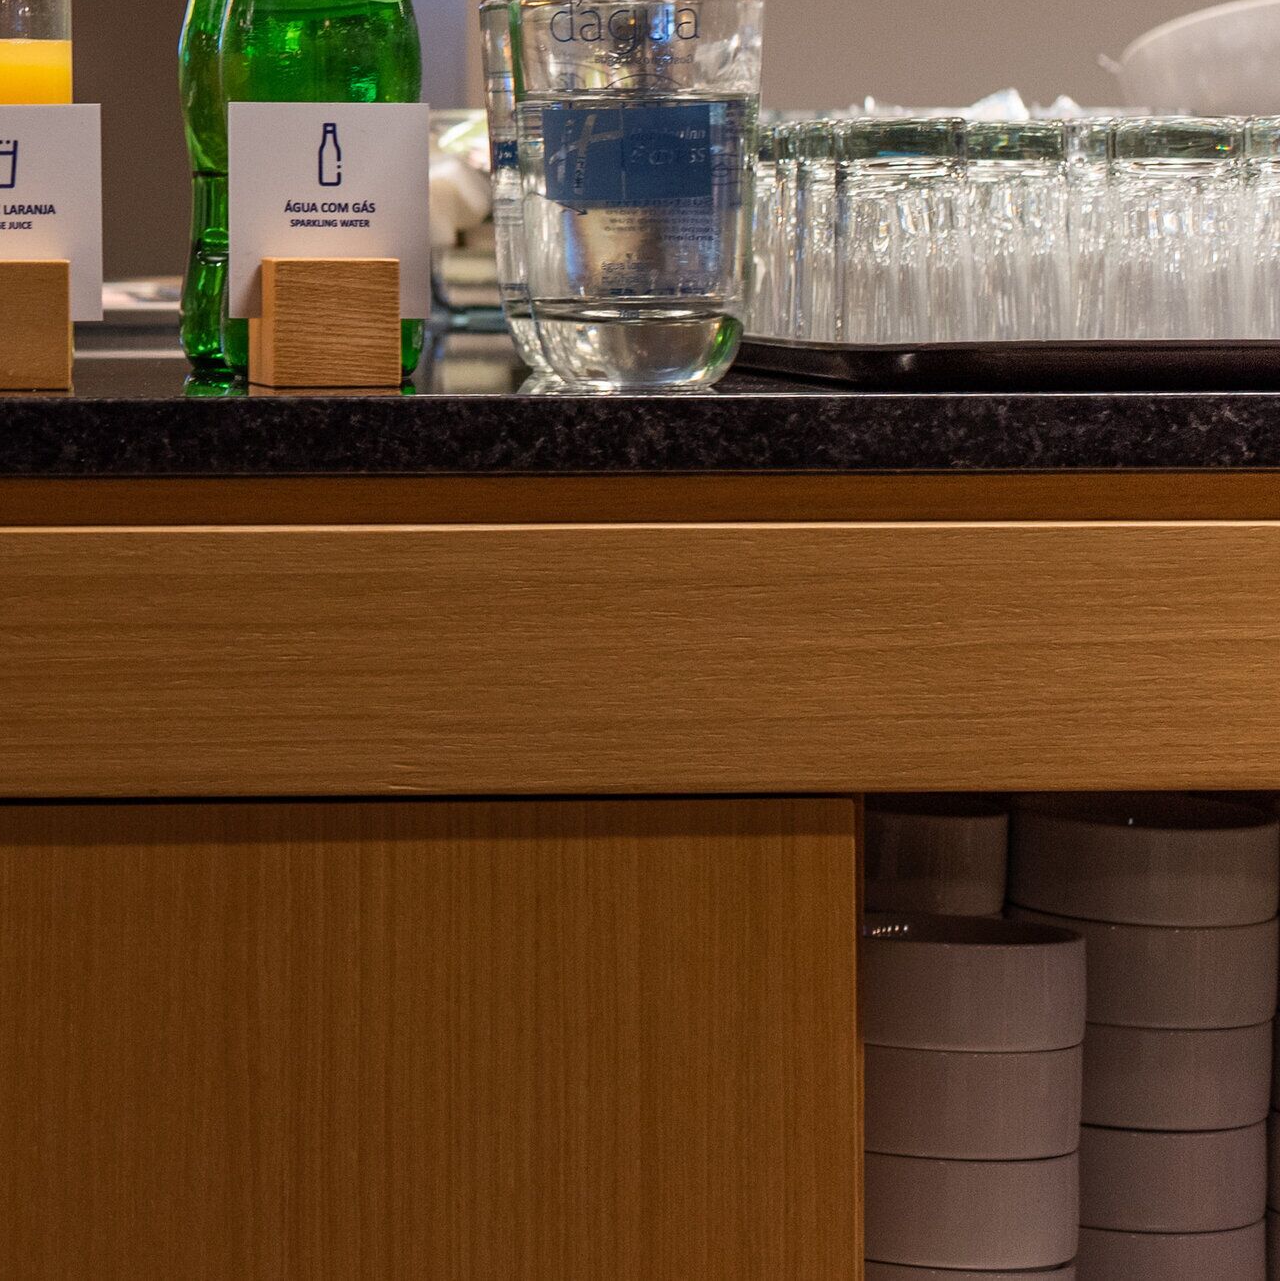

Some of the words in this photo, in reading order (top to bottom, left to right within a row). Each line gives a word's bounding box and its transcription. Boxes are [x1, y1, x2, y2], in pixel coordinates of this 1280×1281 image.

[3, 204, 56, 215] LARANJA
[284, 199, 318, 213] ÁGUA
[321, 202, 349, 213] COM
[352, 199, 376, 213] GÁS
[8, 221, 32, 229] JUICE
[290, 219, 338, 228] SPARKLING
[340, 219, 370, 228] WATER
